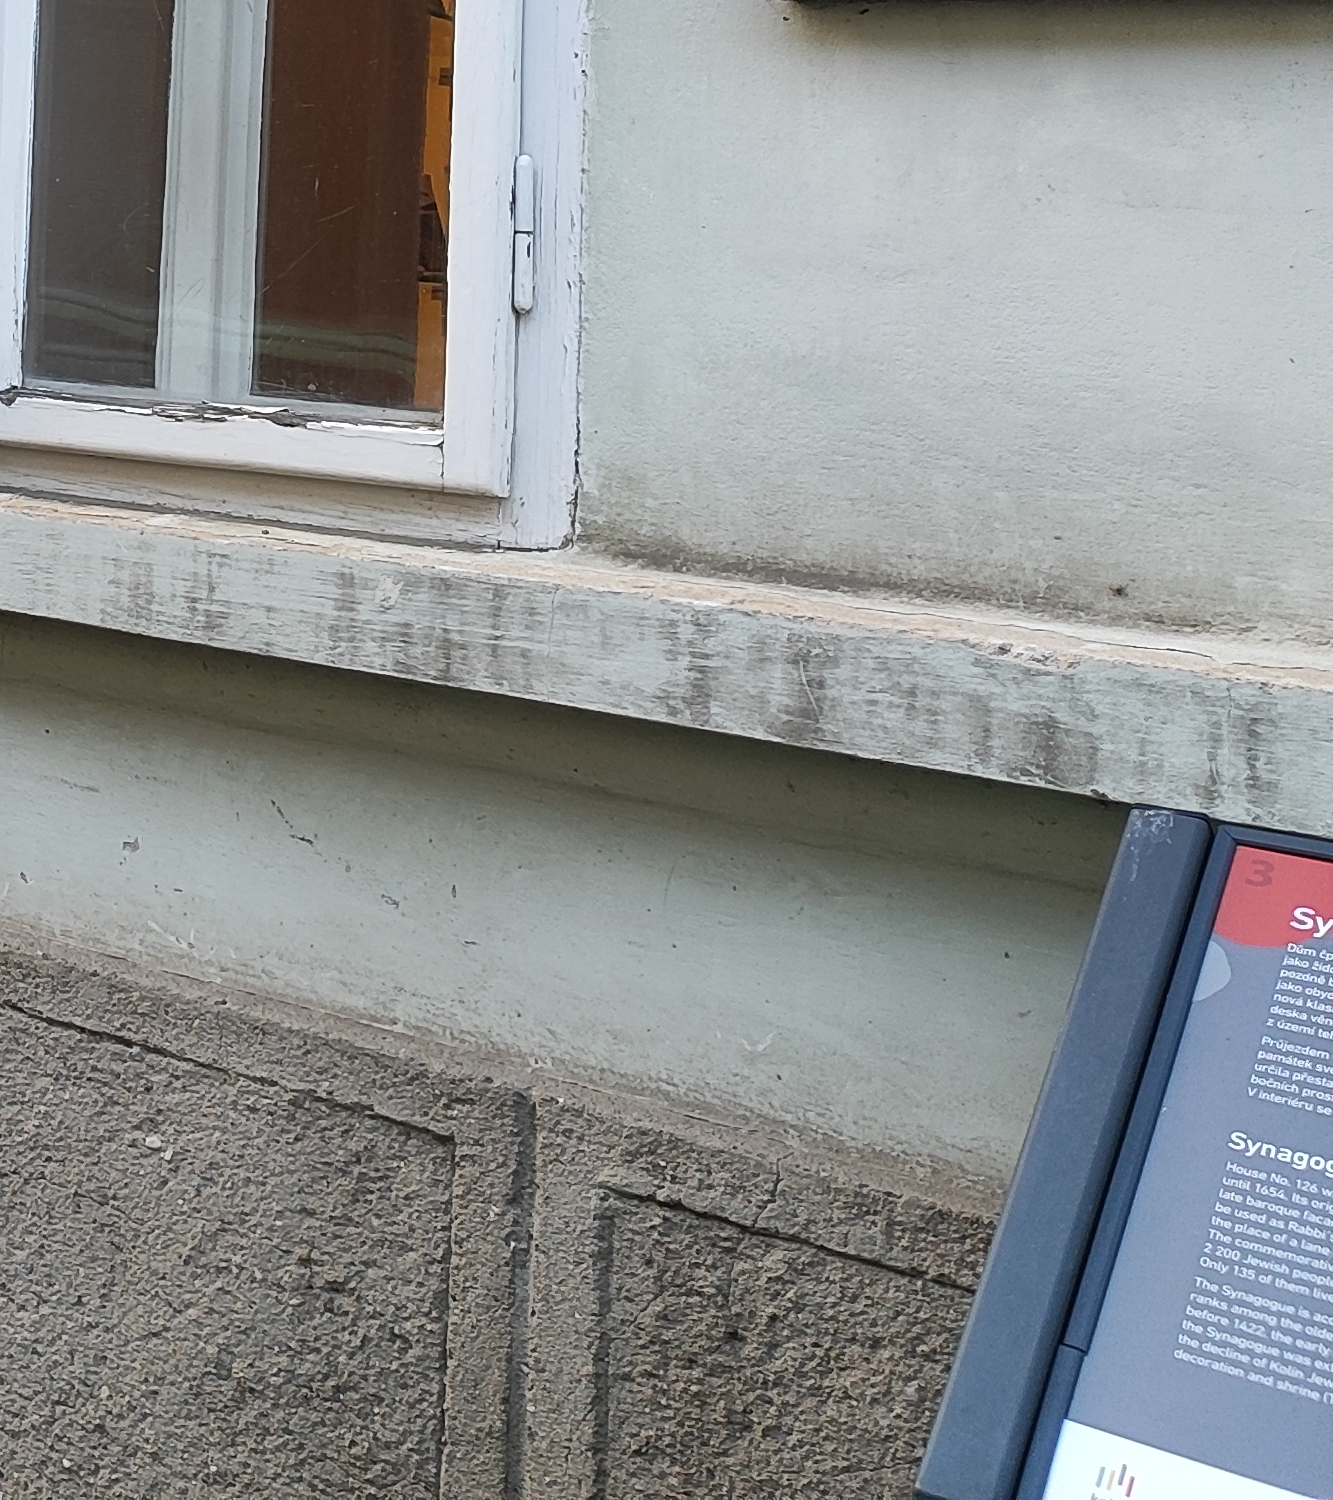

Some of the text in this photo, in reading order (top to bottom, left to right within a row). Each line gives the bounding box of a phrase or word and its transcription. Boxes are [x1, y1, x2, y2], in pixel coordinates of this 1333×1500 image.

[1245, 859, 1275, 887] 3
[1222, 1176, 1251, 1191] until
[1225, 1160, 1268, 1181] House
[1295, 1178, 1319, 1194] 126
[1214, 1201, 1285, 1229] be used as
[1218, 1188, 1301, 1218] late baroque
[1208, 1228, 1233, 1244] The
[1199, 1256, 1256, 1281] Only 135
[1215, 1245, 1241, 1261] 200
[1242, 1254, 1290, 1275] Jewish
[1194, 1276, 1296, 1314] The Synagogue
[1173, 1348, 1274, 1388] decoration and
